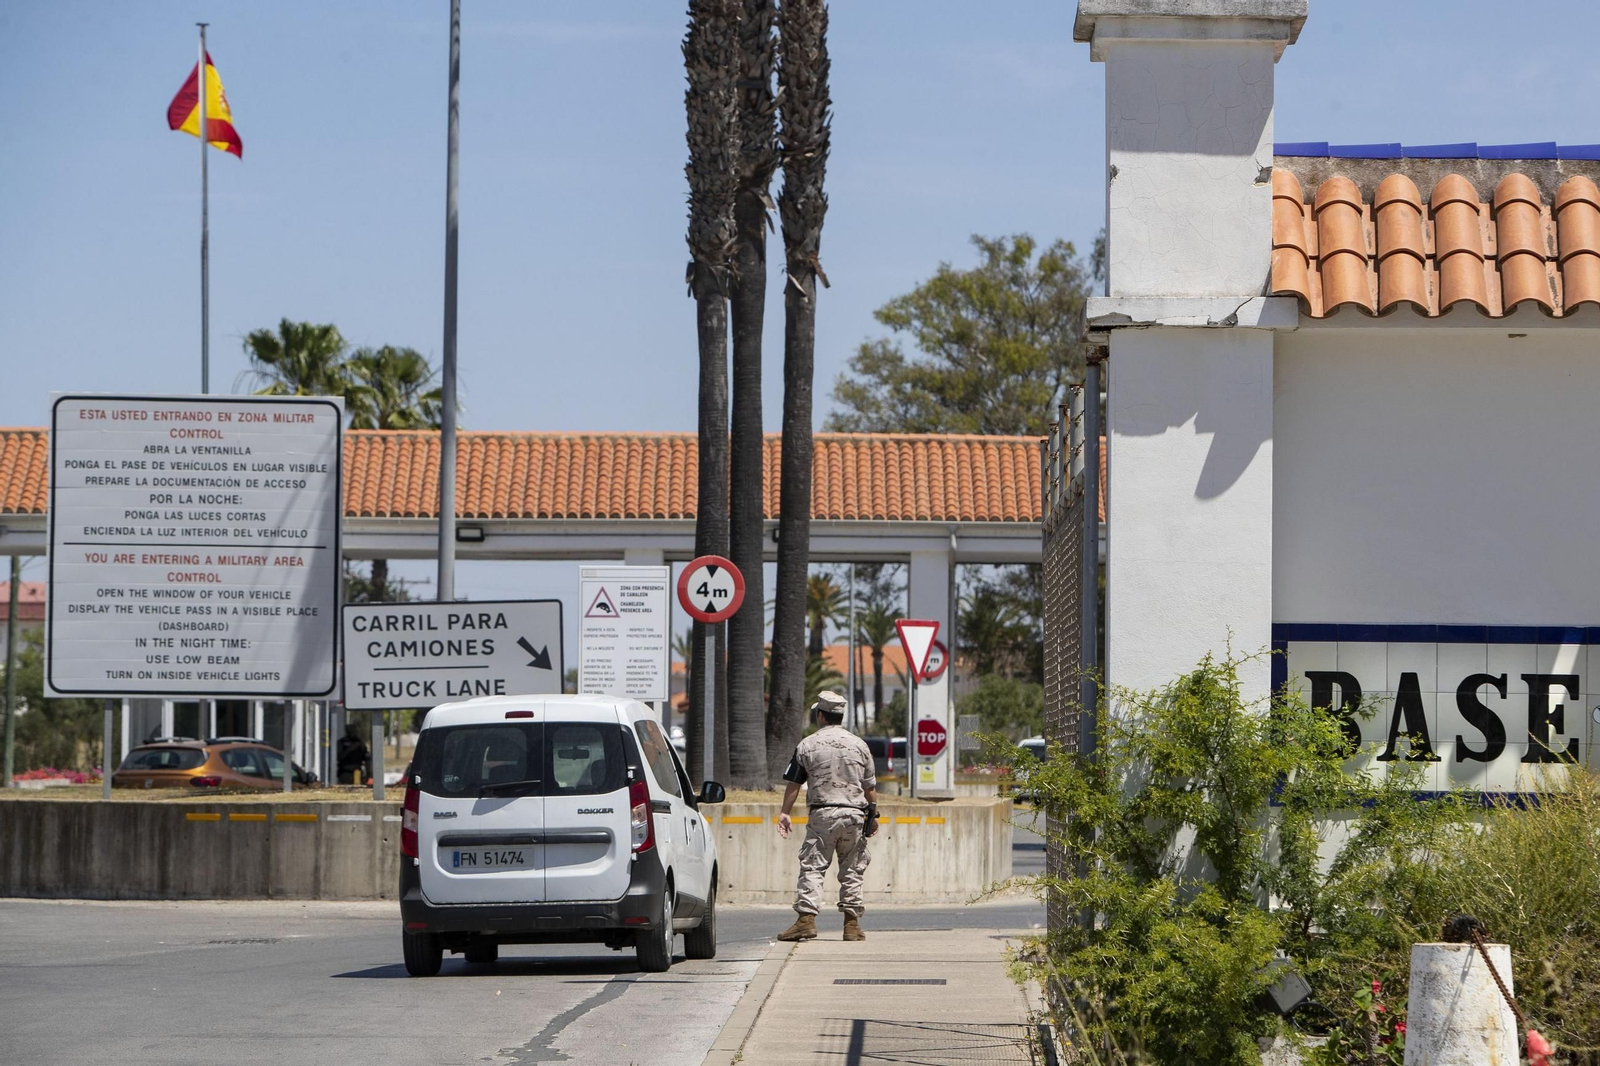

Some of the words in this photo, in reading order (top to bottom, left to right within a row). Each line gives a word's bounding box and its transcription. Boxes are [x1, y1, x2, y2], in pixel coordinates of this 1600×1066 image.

[80, 410, 106, 419] ESTA
[112, 411, 147, 421] USTED
[154, 411, 212, 421] ENTRANDO
[218, 412, 231, 422] EN
[238, 413, 267, 422] ZONA
[274, 414, 314, 423] MILITAR
[170, 428, 223, 439] CONTROL
[144, 446, 169, 454] ABRA
[175, 446, 187, 454] LA
[192, 446, 251, 455] VENTANILLA
[65, 460, 99, 469] PONGA
[105, 461, 116, 469] EL
[122, 461, 146, 470] PASE
[152, 462, 165, 470] DE
[170, 460, 228, 471] VEHÍCULOS
[234, 463, 246, 471] EN
[252, 463, 284, 472] LUGAR
[290, 464, 327, 472] VISIBLE
[86, 477, 130, 485] PREPARE
[136, 477, 148, 486] LA
[153, 476, 240, 487] DOCUMENTACIÓN
[246, 479, 258, 487] DE
[264, 480, 306, 488] ACCESO
[150, 495, 172, 503] POR
[179, 495, 193, 503] LA
[199, 495, 242, 504] NOCHE:
[125, 511, 159, 520] PONGA
[165, 511, 183, 520] LAS
[189, 512, 221, 520] LUCES
[227, 512, 266, 521] CORTAS
[84, 527, 135, 535] ENCIENDA
[141, 528, 153, 536] LA
[158, 528, 175, 536] LUZ
[181, 528, 228, 537] INTERIOR
[234, 529, 252, 537] DEL
[85, 554, 107, 564] YOU
[114, 554, 135, 564] ARE
[142, 555, 199, 564] ENTERING
[205, 556, 212, 565] A
[218, 556, 268, 566] MILITARY
[274, 557, 303, 566] AREA
[168, 572, 221, 582] CONTROL
[97, 589, 123, 598] OPEN
[130, 589, 147, 598] THE
[153, 590, 194, 599] WINDOW
[200, 590, 212, 599] OF
[218, 590, 244, 599] YOUR
[249, 591, 291, 600] VEHICLE
[696, 582, 709, 597] 4
[713, 588, 727, 598] m
[69, 605, 109, 613] DISPLAY
[115, 605, 133, 614] THE
[139, 606, 180, 614] VEHICLE
[186, 606, 212, 615] PASS
[217, 607, 226, 615] IN
[232, 607, 238, 615] A
[243, 607, 280, 616] VISIBLE
[287, 608, 318, 616] PLACE
[158, 622, 228, 632] (DASHBOARD)
[353, 614, 438, 632] CARRIL
[448, 613, 508, 630] PARA
[135, 638, 146, 647] IN
[153, 638, 173, 647] THE
[181, 639, 215, 648] NIGHT
[221, 639, 251, 648] TIME:
[368, 639, 494, 658] CAMIONES
[146, 655, 169, 664] USE
[177, 656, 202, 664] LOW
[208, 656, 239, 664] BEAM
[106, 671, 132, 679] TURN
[138, 671, 151, 679] ON
[158, 672, 191, 680] INSIDE
[197, 672, 239, 680] VEHICLE
[245, 672, 280, 681] LIGHTS
[358, 681, 436, 698] TRUCK
[447, 680, 506, 696] LANE
[1305, 671, 1579, 763] BASE
[918, 732, 946, 743] TOP
[461, 853, 476, 865] FN
[485, 852, 524, 865] 51474
